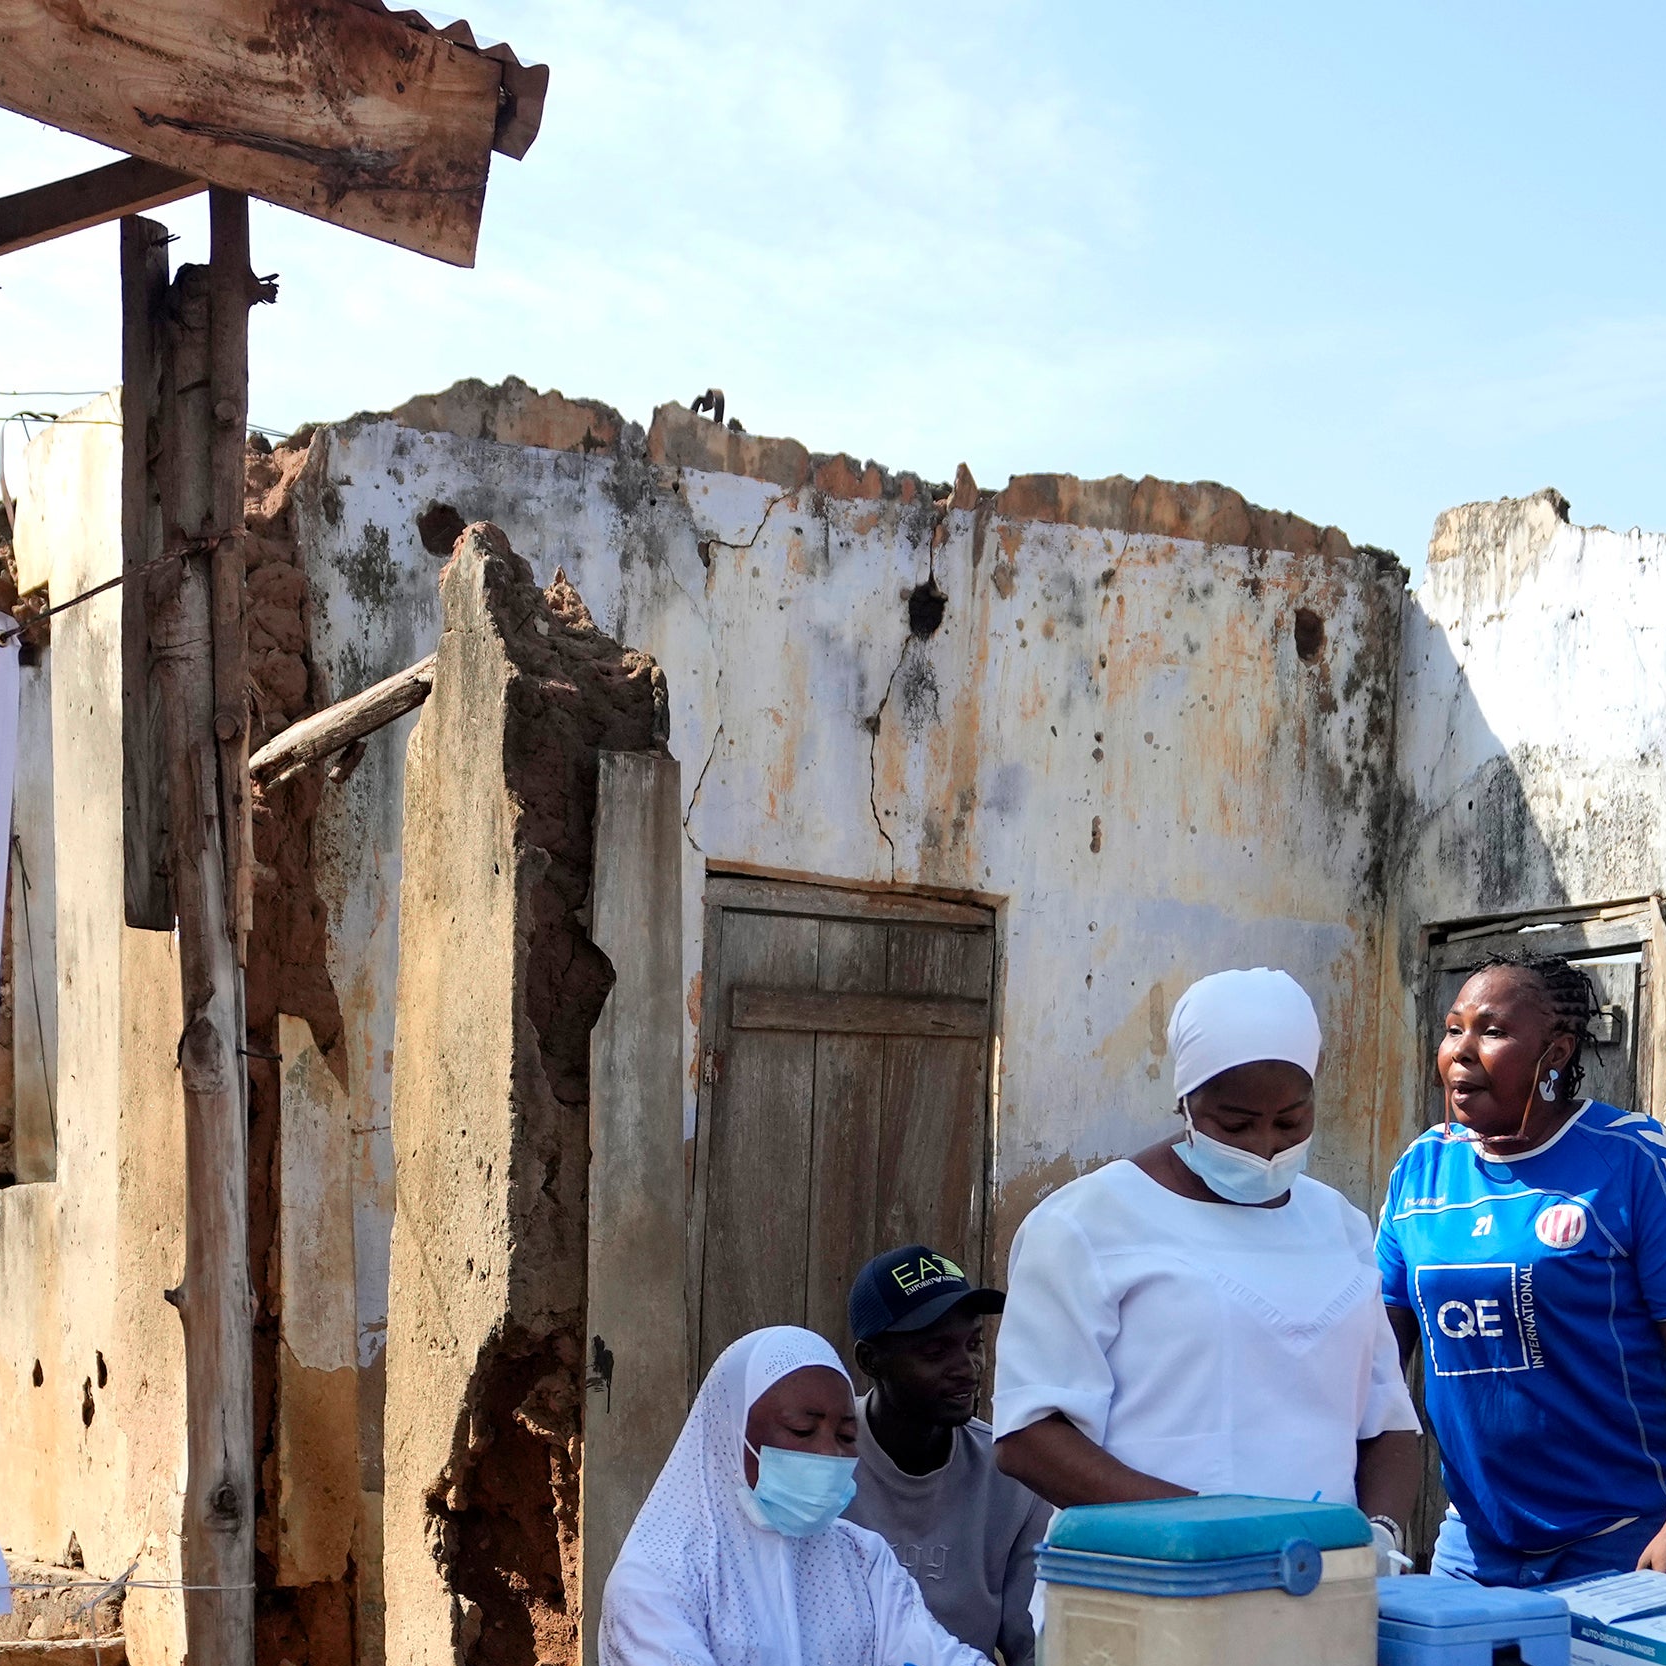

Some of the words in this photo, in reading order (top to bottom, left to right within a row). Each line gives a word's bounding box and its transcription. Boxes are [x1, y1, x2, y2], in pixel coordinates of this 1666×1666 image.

[1471, 1214, 1493, 1237] 21
[904, 1279, 934, 1296] EMPORIO
[1437, 1299, 1504, 1339] QE
[1520, 1263, 1545, 1369] INTERNATIONAL
[1581, 1627, 1624, 1648] AUTO-DISABLE
[1625, 1639, 1656, 1657] SYRINGES
